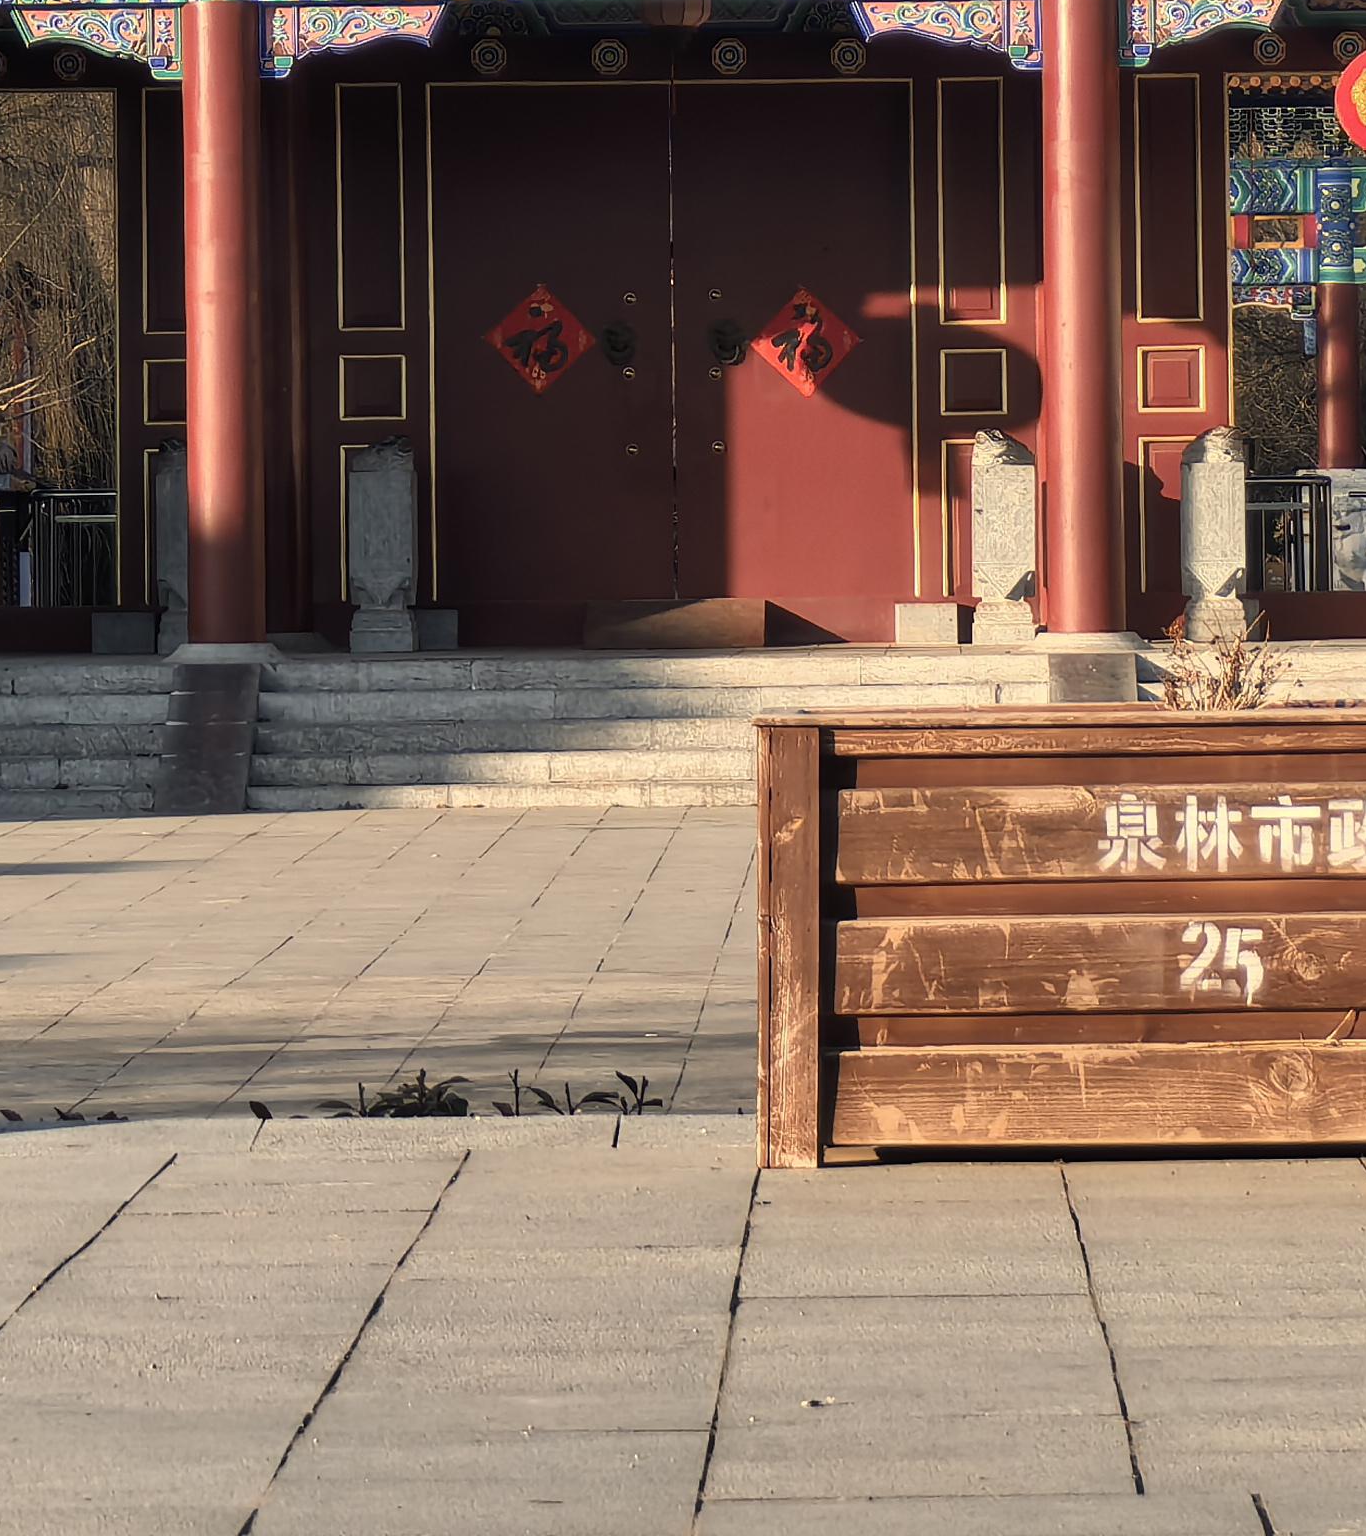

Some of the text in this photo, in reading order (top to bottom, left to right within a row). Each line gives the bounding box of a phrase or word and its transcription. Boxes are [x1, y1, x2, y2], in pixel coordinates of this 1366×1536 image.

[505, 306, 569, 373] 福
[771, 303, 833, 373] 福
[1179, 921, 1264, 1002] 25
